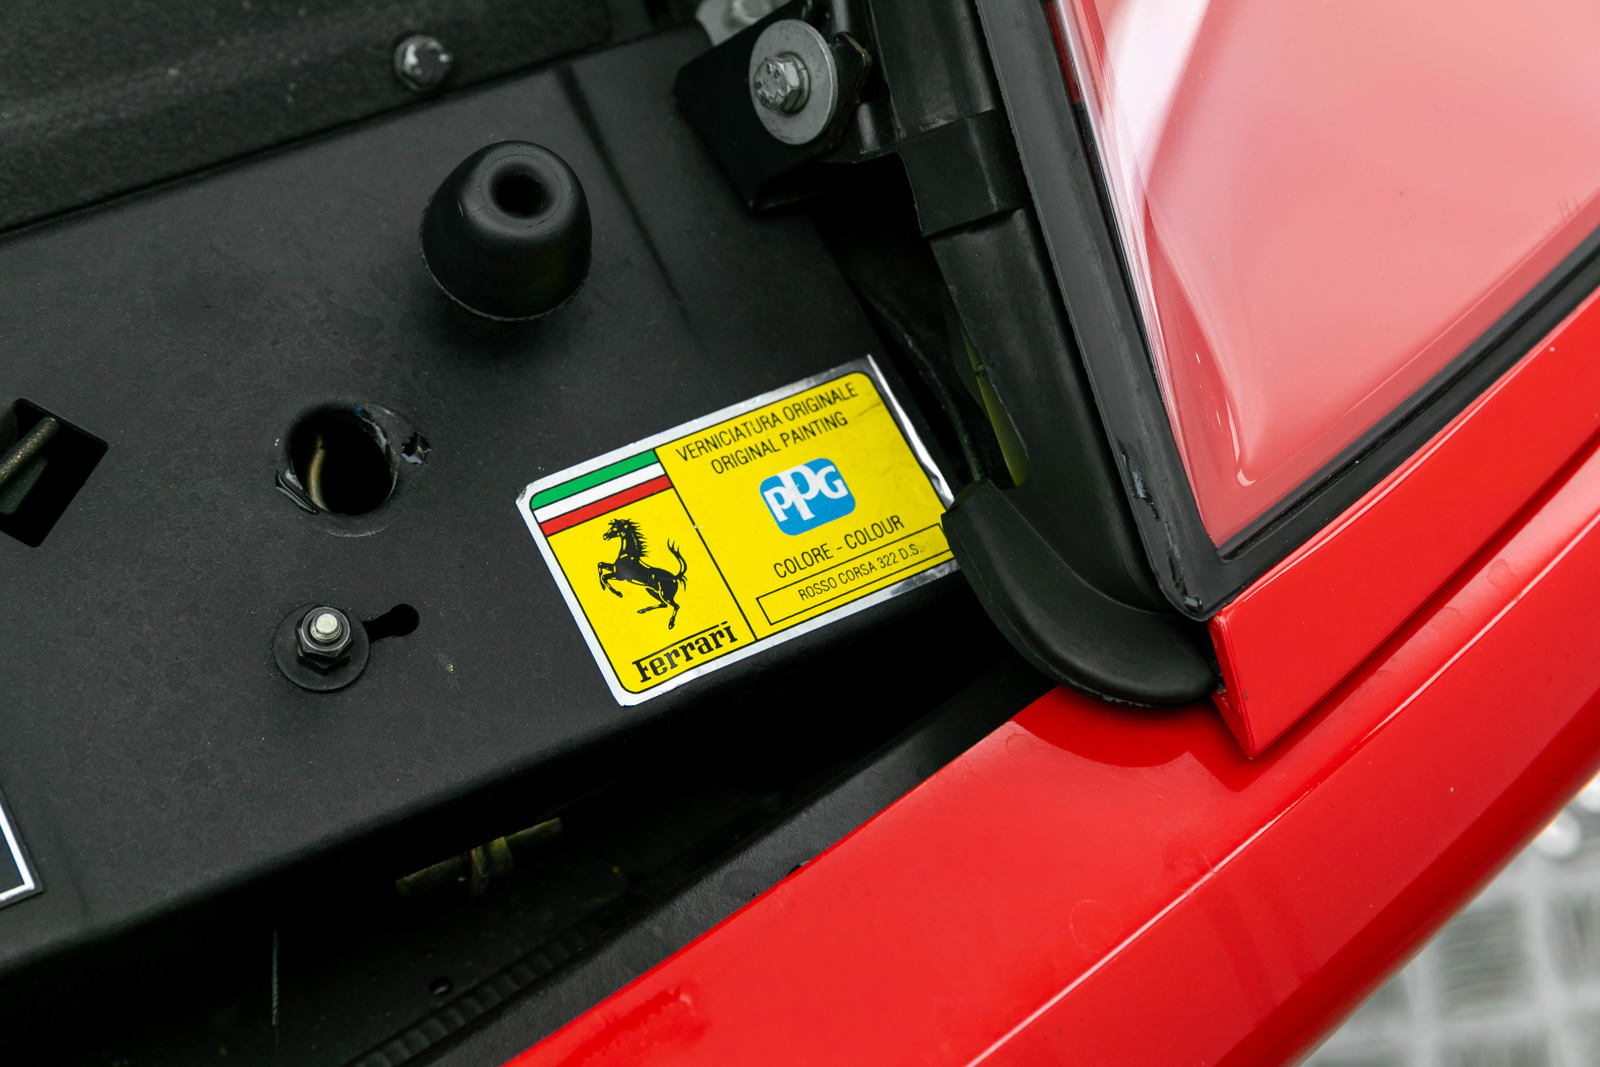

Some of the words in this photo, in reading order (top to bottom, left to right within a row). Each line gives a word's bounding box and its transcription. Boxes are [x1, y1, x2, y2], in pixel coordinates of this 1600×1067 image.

[676, 411, 783, 462] VERNICIATURA
[782, 382, 858, 422] ORIGINALE
[711, 438, 782, 474] ORIGINAL
[780, 410, 848, 448] PAINTING
[763, 464, 849, 522] PPG
[773, 543, 834, 579] COLORE
[844, 514, 905, 550] COLOUR
[798, 577, 838, 601] ROSSO
[838, 560, 878, 585] CORSA
[876, 552, 899, 569] 322
[632, 621, 737, 682] Ferrari
